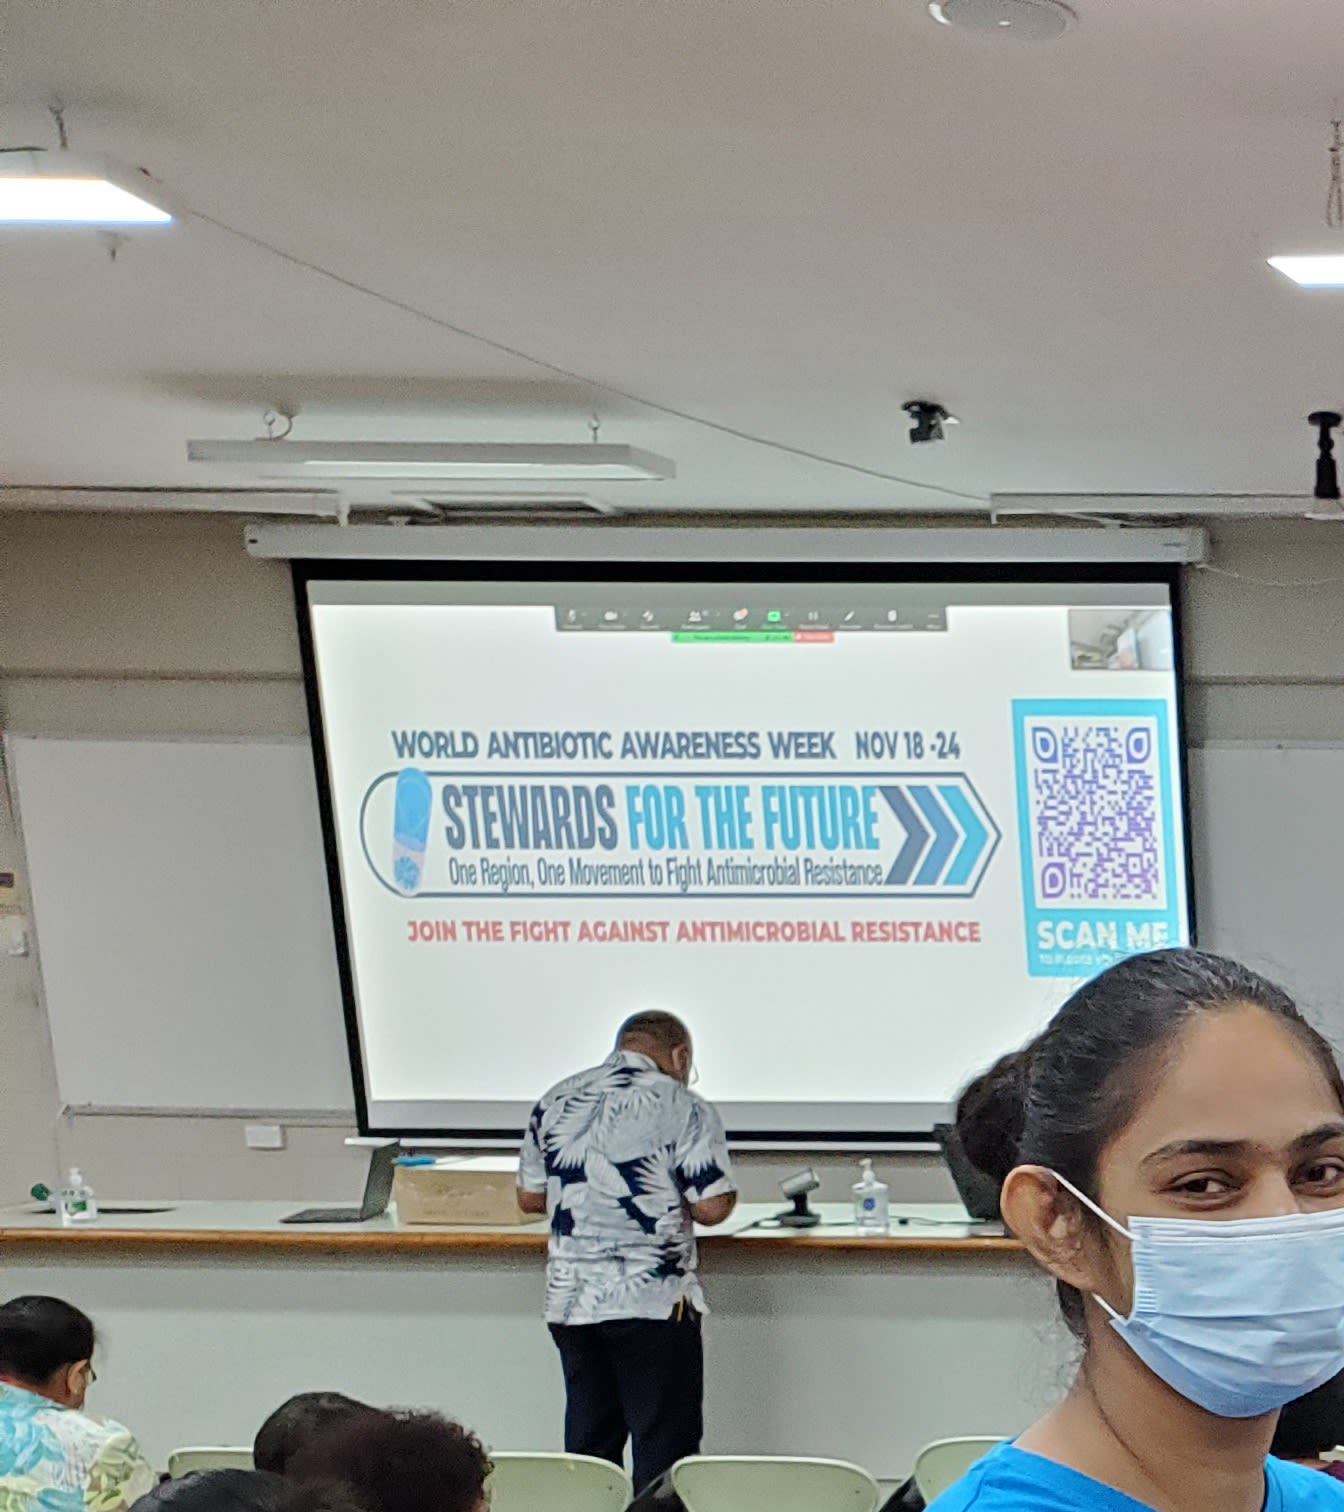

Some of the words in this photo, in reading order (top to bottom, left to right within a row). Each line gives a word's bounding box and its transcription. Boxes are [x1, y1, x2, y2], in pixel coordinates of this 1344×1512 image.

[392, 730, 479, 759] WORLD
[487, 731, 613, 760] ANTIBIOTIC
[620, 731, 761, 760] AWARENESS
[767, 731, 837, 760] WEEK
[855, 731, 898, 760] NOV
[904, 731, 924, 760] 18
[442, 784, 618, 850] STEWARDS
[625, 784, 690, 850] FOR
[694, 785, 755, 850] THE
[761, 785, 880, 850] FUTURE
[450, 857, 477, 886] One
[480, 857, 535, 893] Region,
[537, 857, 566, 886] One
[568, 857, 645, 886] Movement
[648, 857, 663, 886] to
[666, 857, 703, 893] Fight
[707, 857, 801, 886] Antimicrobial
[804, 857, 883, 886] Resistance
[407, 920, 457, 942] JOIN
[462, 921, 505, 942] THE
[510, 921, 571, 942] FIGHT
[577, 921, 670, 942] AGAINST
[676, 921, 846, 942] ANTIMICROBIAL
[851, 921, 982, 943] RESISTANCE
[1036, 920, 1118, 950] SCAN
[1126, 921, 1169, 950] ME
